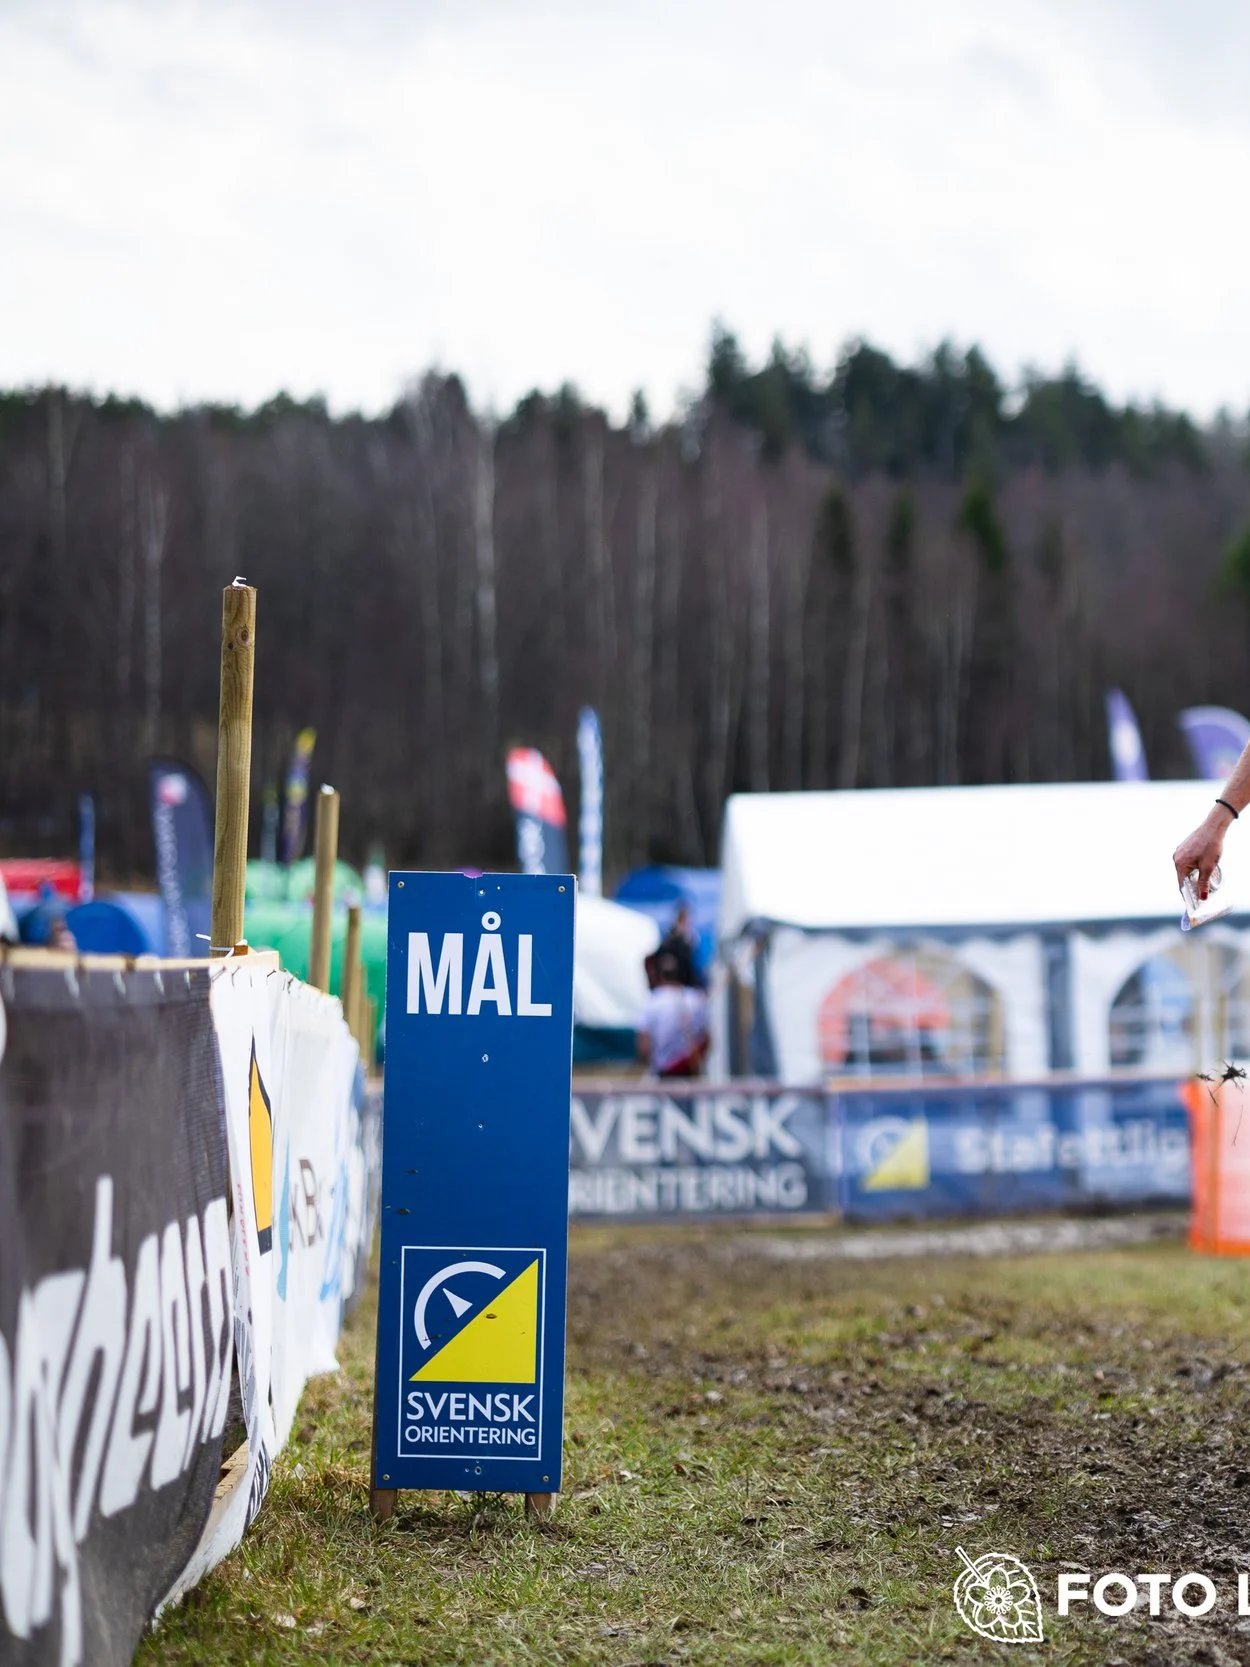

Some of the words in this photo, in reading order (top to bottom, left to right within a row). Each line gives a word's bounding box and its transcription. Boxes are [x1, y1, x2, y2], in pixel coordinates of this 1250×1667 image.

[406, 911, 553, 1017] MÅL
[406, 1391, 536, 1423] SVENSK
[404, 1425, 537, 1447] ORIENTERING
